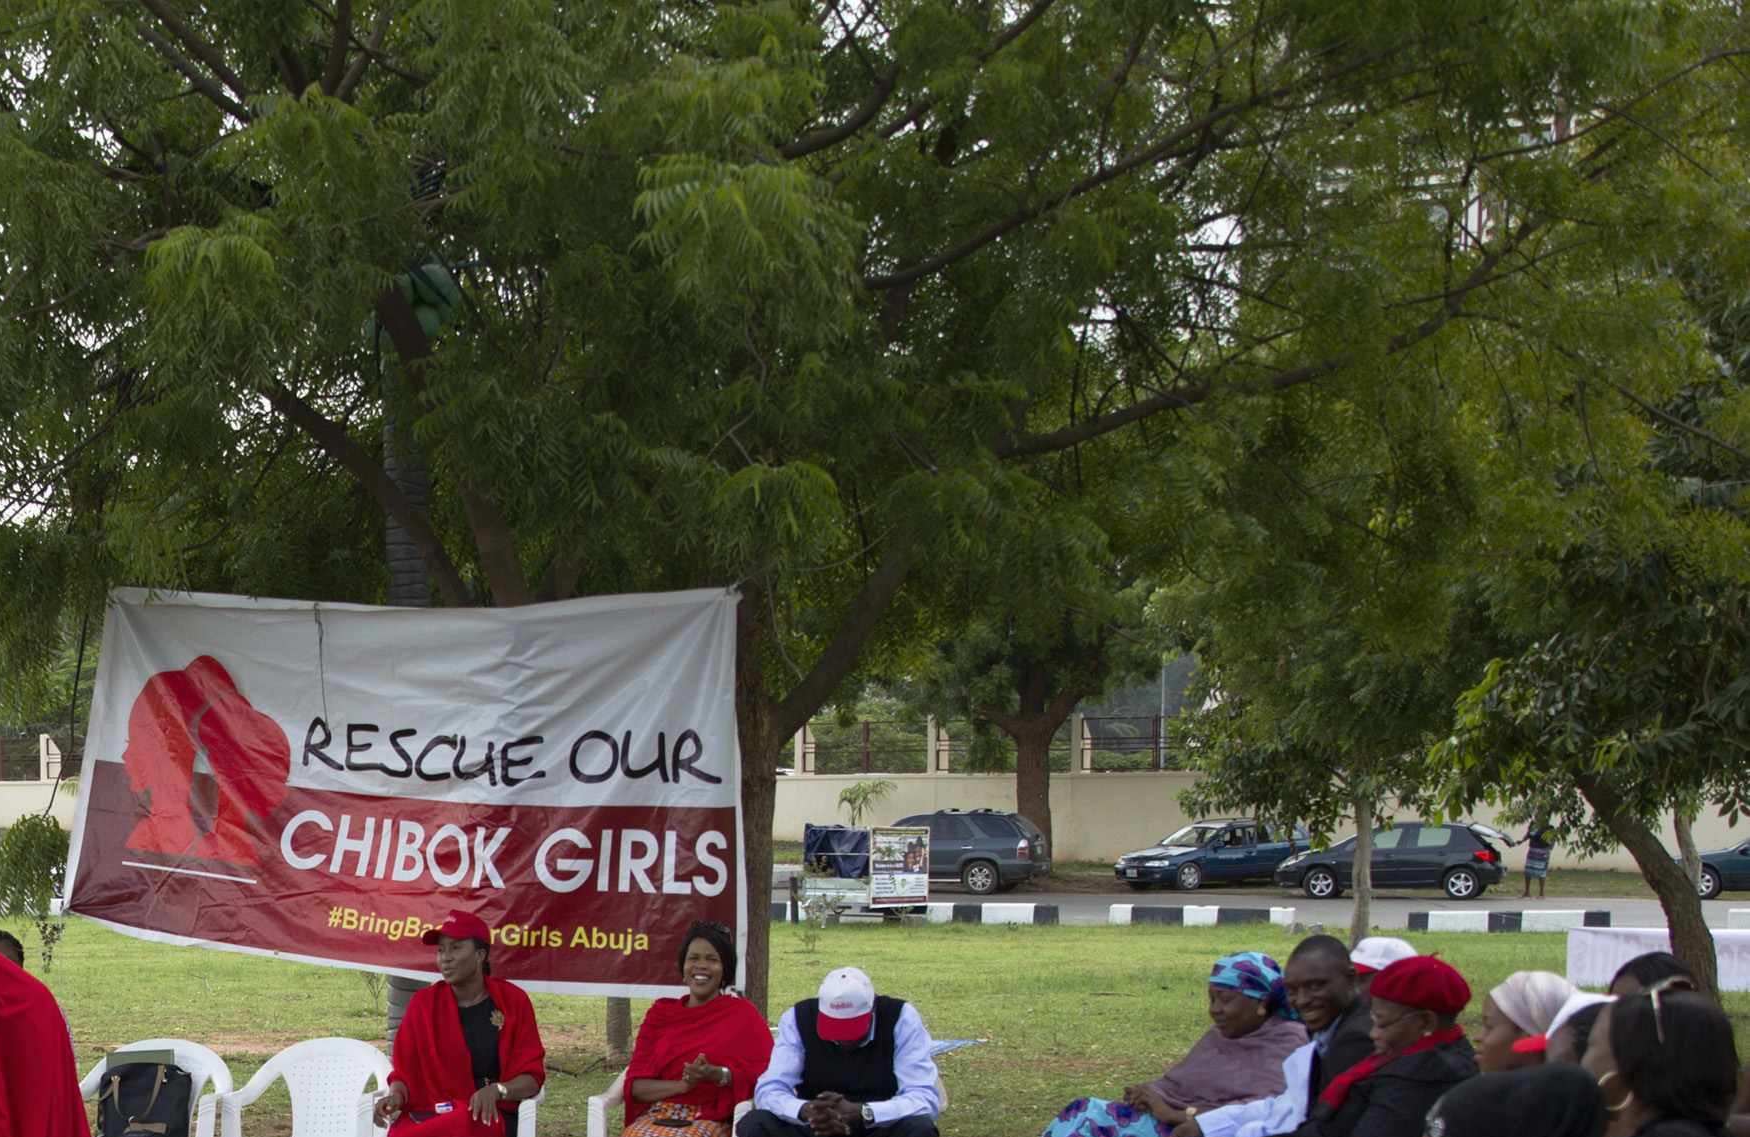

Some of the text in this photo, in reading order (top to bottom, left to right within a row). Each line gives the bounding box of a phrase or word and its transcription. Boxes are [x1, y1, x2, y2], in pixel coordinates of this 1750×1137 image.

[303, 716, 722, 787] RESCUE OUR
[280, 809, 729, 897] CHIBOK GIRLS
[328, 906, 649, 956] #BringBarGirls Abuja
